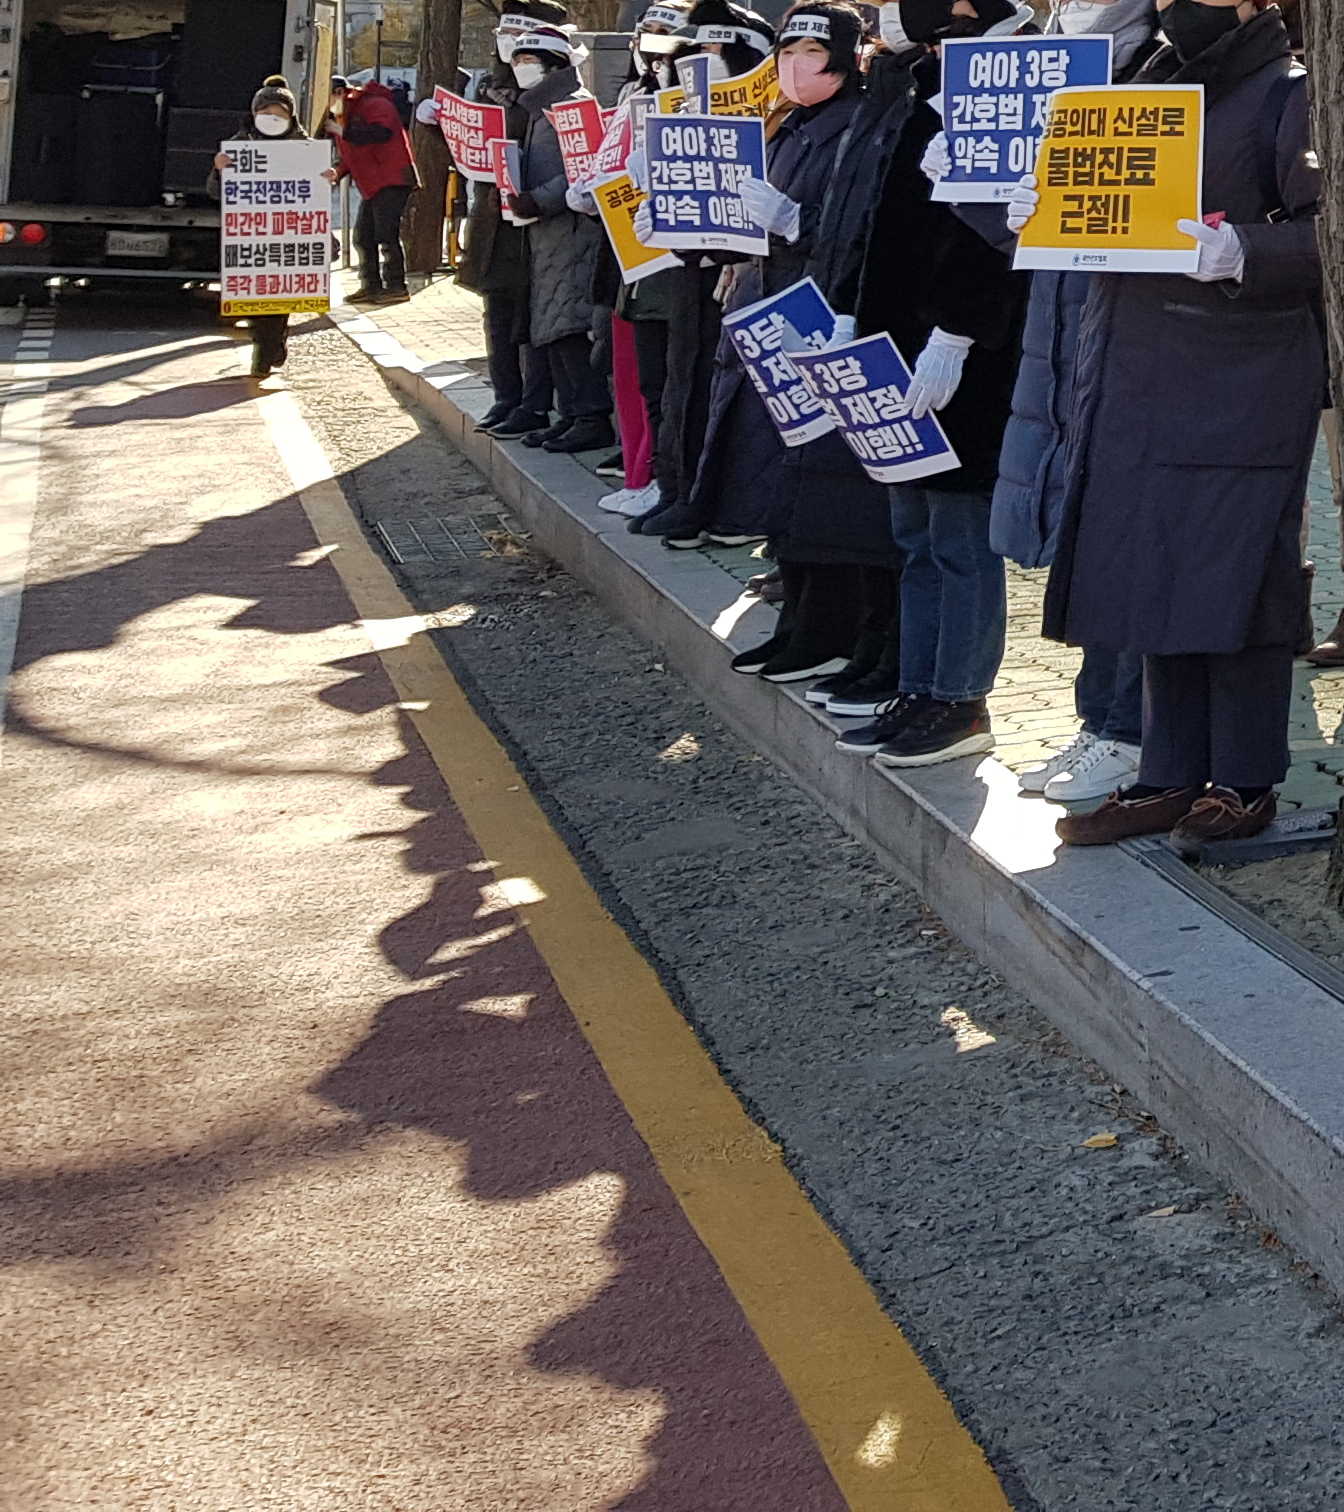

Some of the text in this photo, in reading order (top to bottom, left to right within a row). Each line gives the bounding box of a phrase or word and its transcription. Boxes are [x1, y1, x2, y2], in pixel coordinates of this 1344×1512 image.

[968, 49, 1070, 88] 여야 3당
[951, 92, 1053, 133] 간호법 제
[1112, 107, 1186, 137] 신설로
[661, 126, 708, 158] 여야
[710, 127, 740, 159] 3당
[954, 136, 1000, 174] 약속
[225, 149, 268, 174] 국회는
[651, 160, 716, 191] 간호법
[1047, 146, 1158, 187] 불법진료
[224, 179, 312, 206] 한국전쟁전후
[225, 209, 329, 237] 민간인 피학살자
[655, 195, 701, 226] 약속
[1060, 193, 1131, 235] 근절!!
[225, 241, 326, 269] 배보상특별법을
[226, 274, 252, 296] 즉각
[255, 272, 320, 296] 통과시켜라
[815, 356, 867, 394] 3당
[840, 384, 912, 426] 제정
[846, 420, 925, 463] 이행!!
